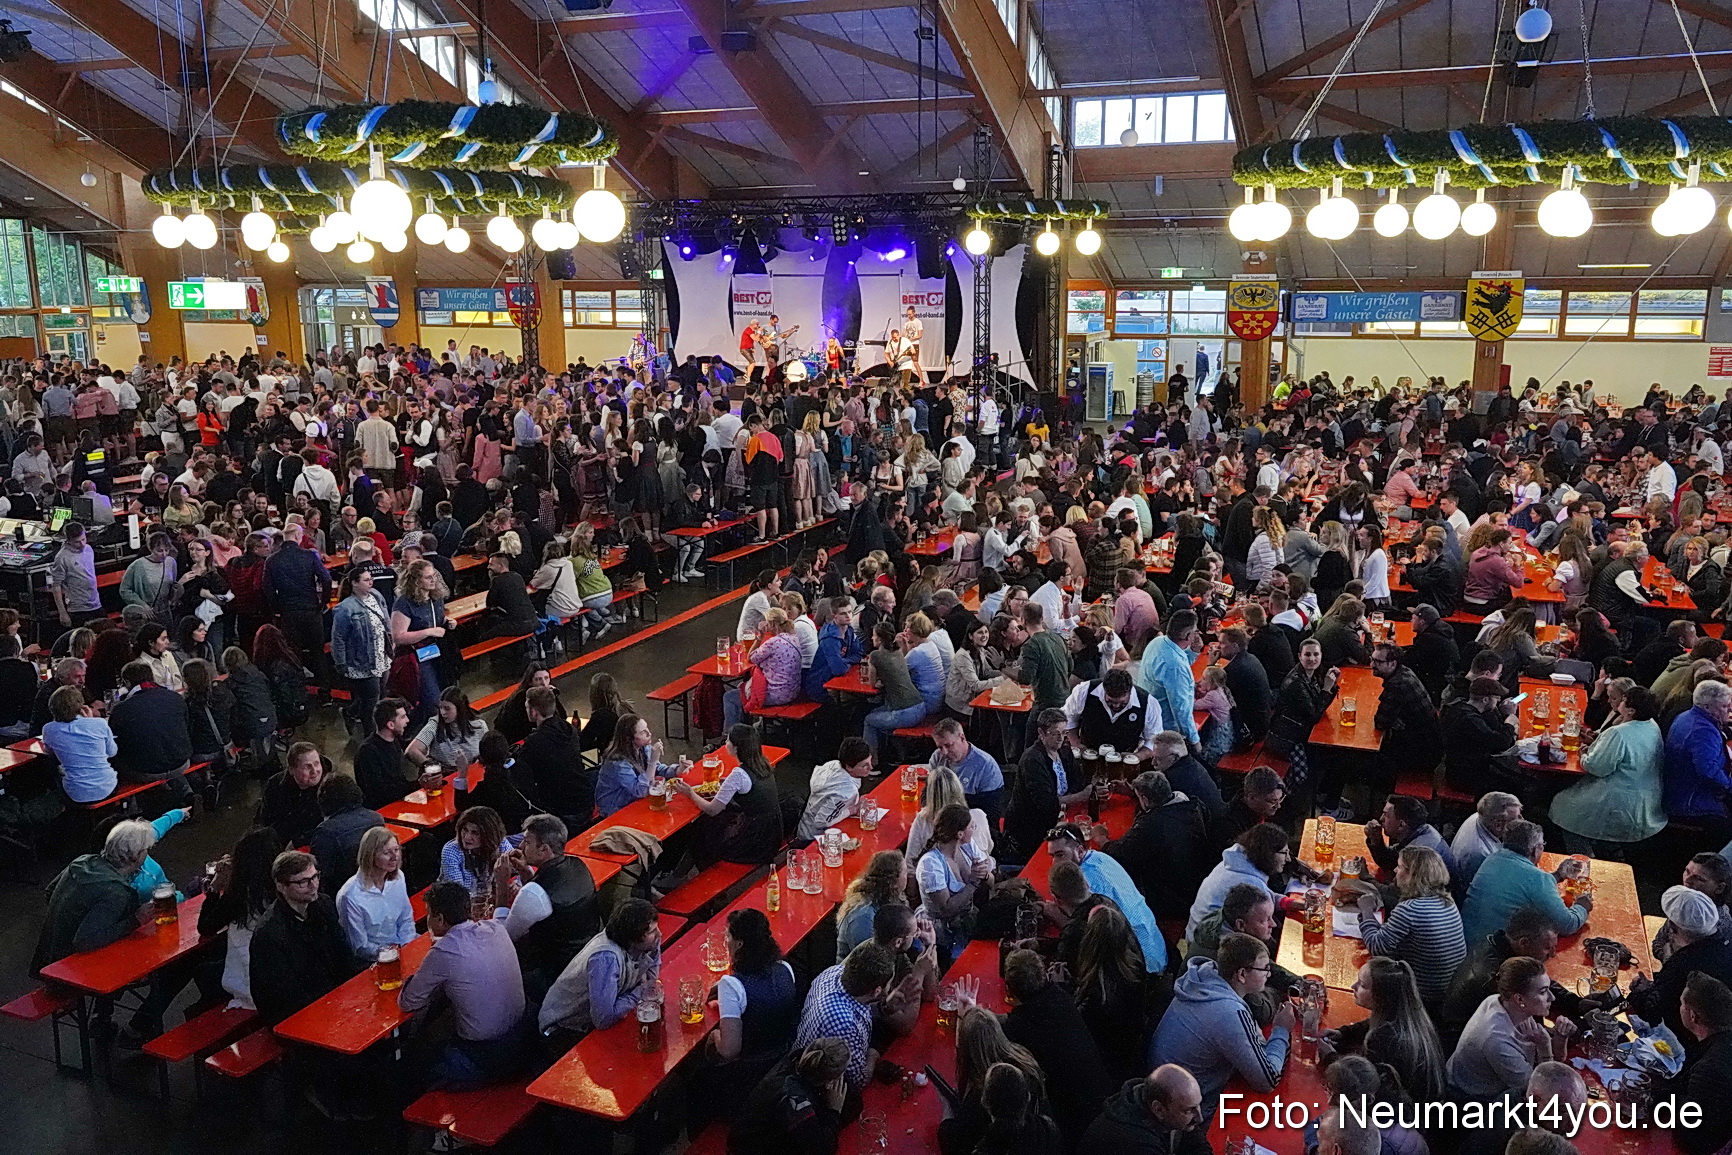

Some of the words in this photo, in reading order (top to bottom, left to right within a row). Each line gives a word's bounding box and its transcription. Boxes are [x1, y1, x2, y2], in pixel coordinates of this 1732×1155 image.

[446, 289, 461, 299] Wir
[462, 288, 488, 302] grüßen
[733, 293, 756, 303] BEST
[757, 292, 772, 305] OF
[902, 294, 926, 305] BEST
[927, 292, 944, 306] OF
[443, 302, 467, 310] unsere
[1339, 294, 1361, 306] Wir
[1364, 293, 1409, 311] grüßen
[1333, 310, 1372, 320] unsere
[1374, 308, 1414, 320] Gäste!
